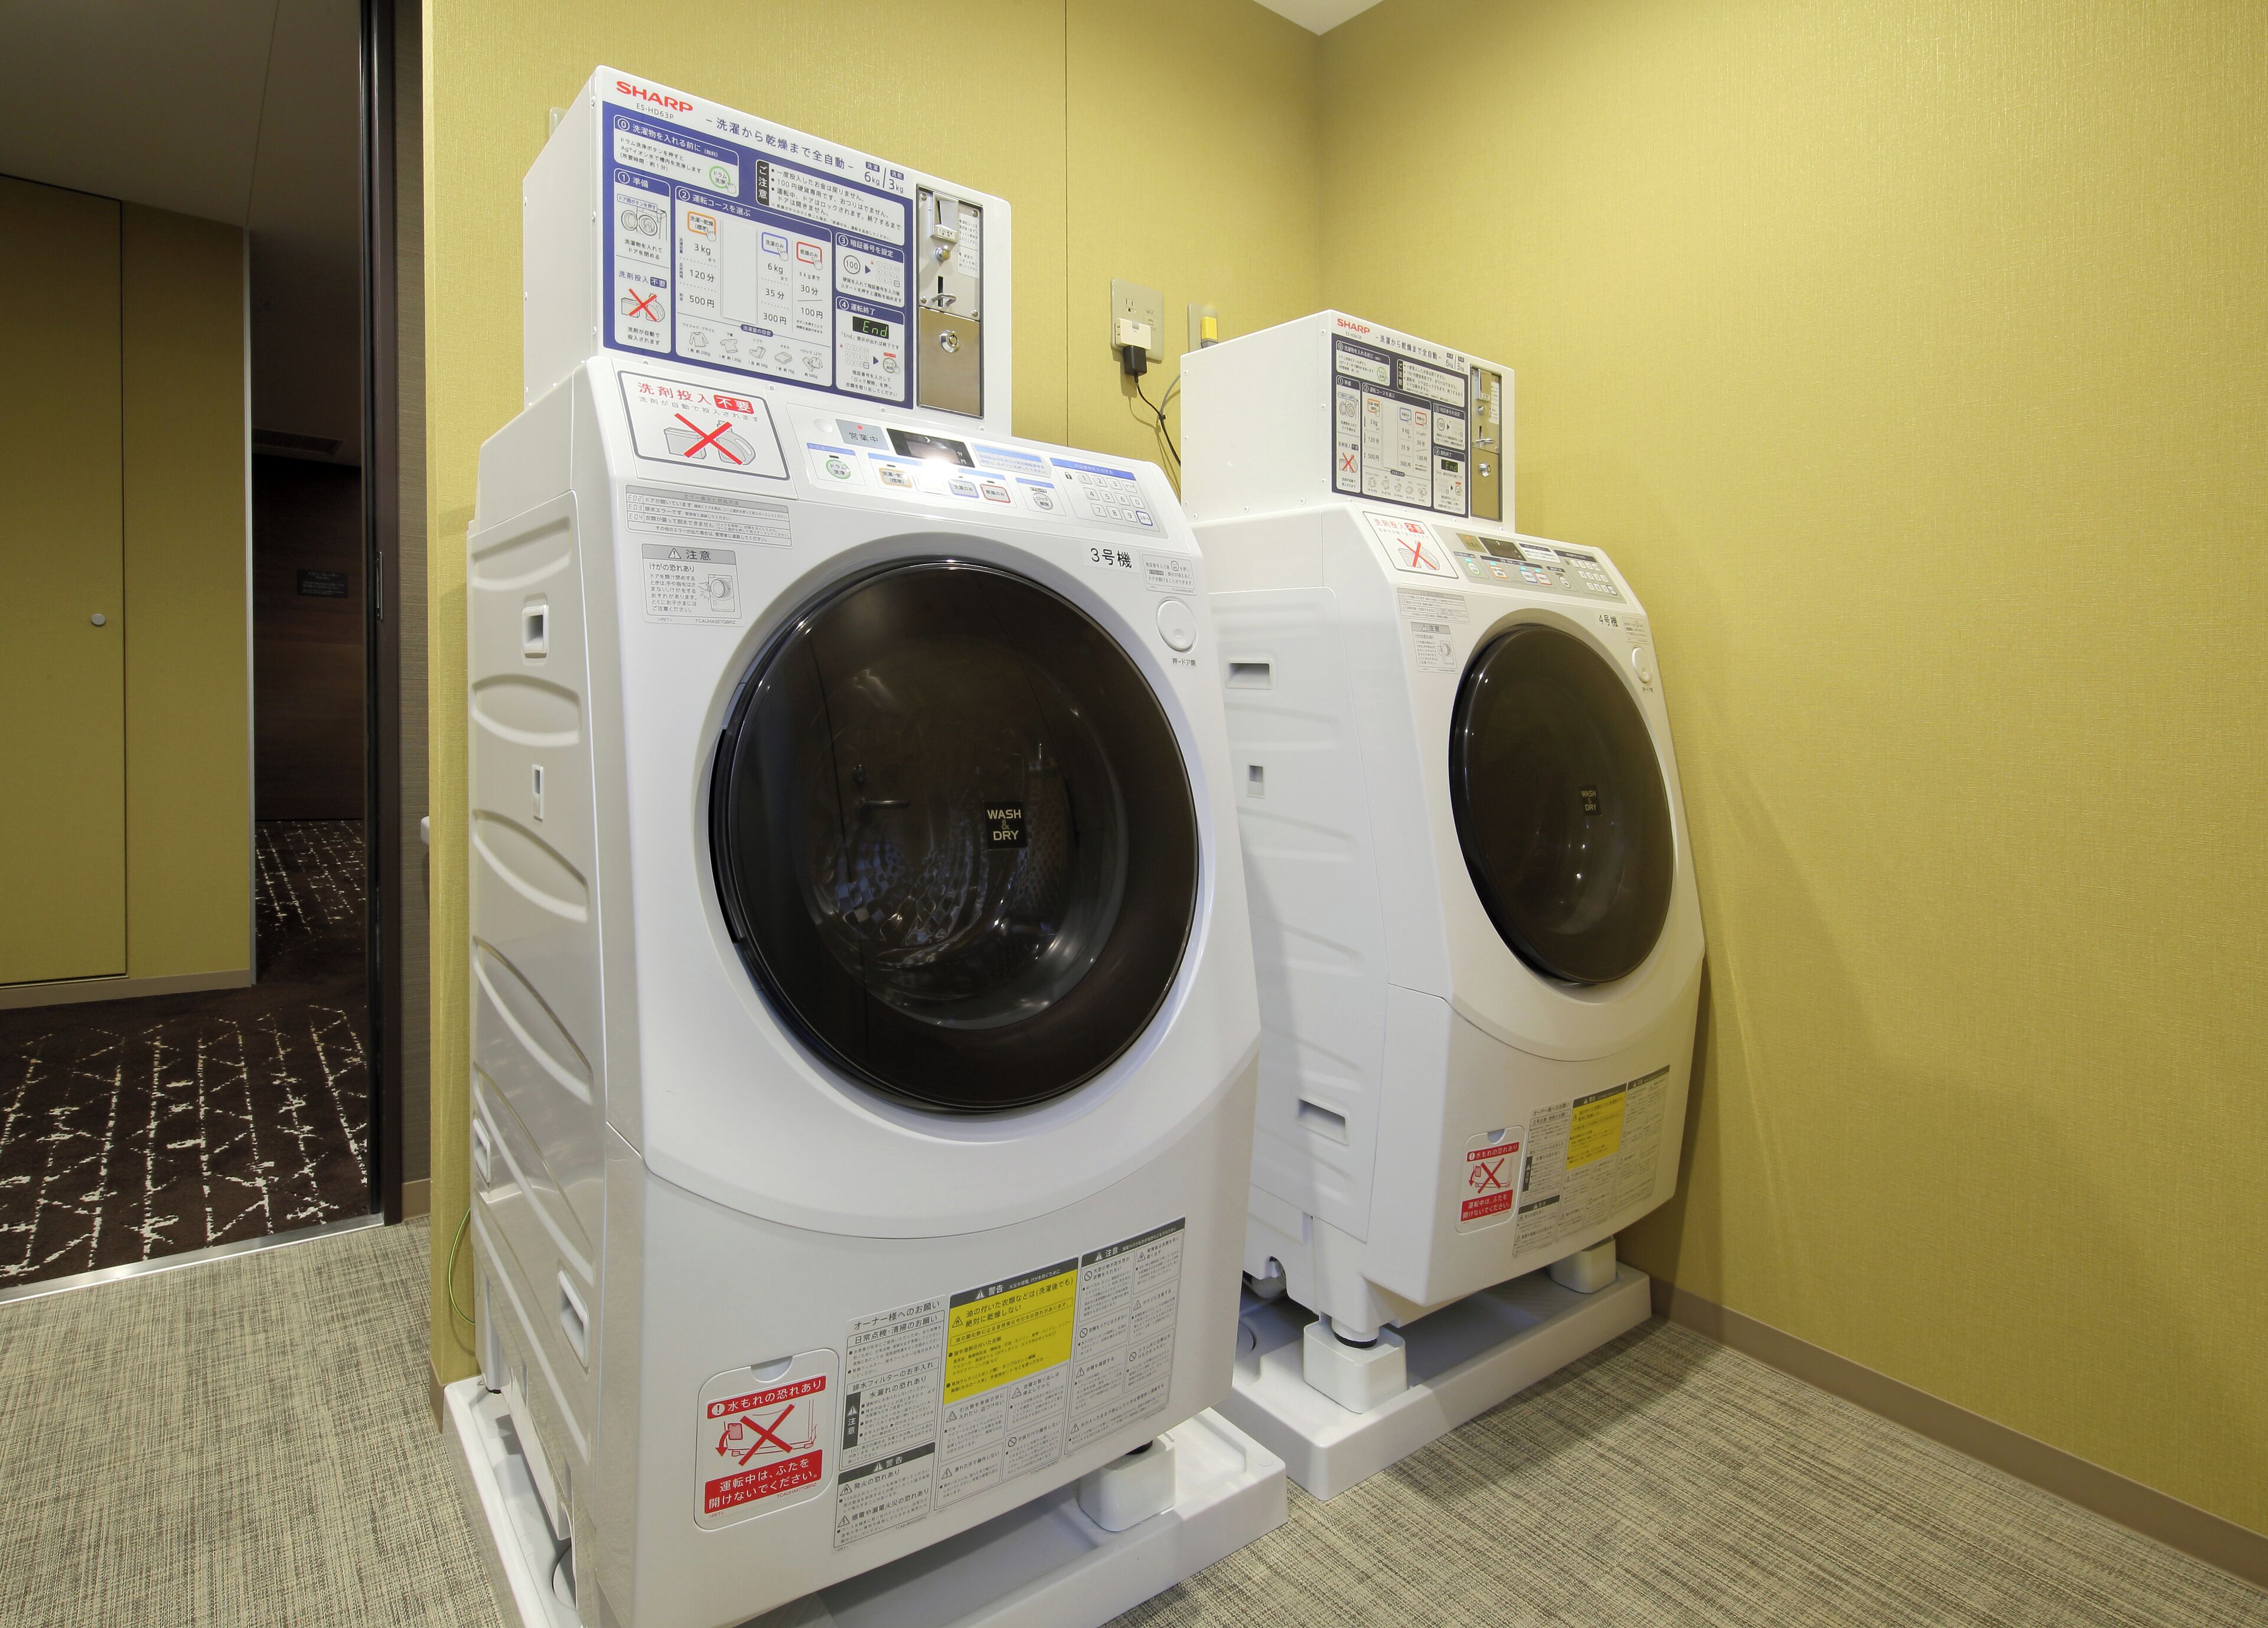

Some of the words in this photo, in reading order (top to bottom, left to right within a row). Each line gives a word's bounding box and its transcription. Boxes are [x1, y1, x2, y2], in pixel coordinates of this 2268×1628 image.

[617, 81, 693, 112] SHARP
[636, 103, 674, 119] ES-HD63P
[633, 124, 700, 152] 洗濯物を入れる前に
[620, 137, 684, 161] ドラム洗浄ボタンを押すと
[633, 178, 649, 188] 準備
[713, 170, 728, 180] ドラム
[758, 165, 768, 200] ご注意
[777, 171, 863, 202] 一度投入したお金は戻りません。
[692, 194, 751, 217] 運転コースを選ぶ
[777, 196, 829, 216] ドアは開きません。
[625, 239, 662, 253] 洗濯物を入れて
[765, 240, 784, 249] 洗濯のみ
[850, 239, 893, 257] 暗証番号を設定
[628, 248, 660, 259] ドアを閉める
[800, 249, 818, 258] 乾燥のみ
[845, 260, 858, 270] 100
[619, 270, 649, 284] 洗剤投入
[651, 278, 666, 288] 不要
[850, 303, 875, 315] 運転終了
[628, 327, 661, 338] 洗剤が自動で
[863, 321, 888, 337] End
[1337, 318, 1370, 334] SHARP
[628, 334, 660, 345] 投入されます
[638, 382, 712, 406] 洗剤投入
[716, 397, 751, 412] 不要
[638, 396, 758, 422] 洗剤が自動で投入されます
[849, 432, 879, 443] 営業中
[645, 498, 692, 508] ドアが開いています
[684, 494, 739, 506] エラー表示と対処方法
[645, 506, 682, 515] 排水エラーです
[686, 550, 711, 560] 注意
[1090, 547, 1132, 569] 3号機
[649, 563, 695, 572] けがの恐れあり
[1599, 615, 1618, 627] 4号機
[987, 809, 1021, 820] WASH
[1001, 820, 1010, 830] &
[993, 830, 1019, 840] DRY
[1106, 1247, 1118, 1257] 注意
[988, 1285, 1003, 1296] 警告
[854, 1301, 940, 1330] オーナー様へのお願い
[966, 1305, 1021, 1327] 絶対に乾燥しない
[855, 1315, 937, 1344] 日常点検・清掃のお願い
[853, 1362, 933, 1392] 排水フィルターのお手入れ
[869, 1376, 926, 1399] 水漏れの恐れあり
[728, 1380, 822, 1412] 水もれの恐れあり
[886, 1456, 903, 1467] 警告
[719, 1458, 809, 1493] 運転中は、ふたを
[854, 1469, 900, 1489] 発火の恐れあり
[709, 1474, 817, 1509] 開けないでください。
[852, 1488, 929, 1521] 感電や漏電火災の恐れあり
